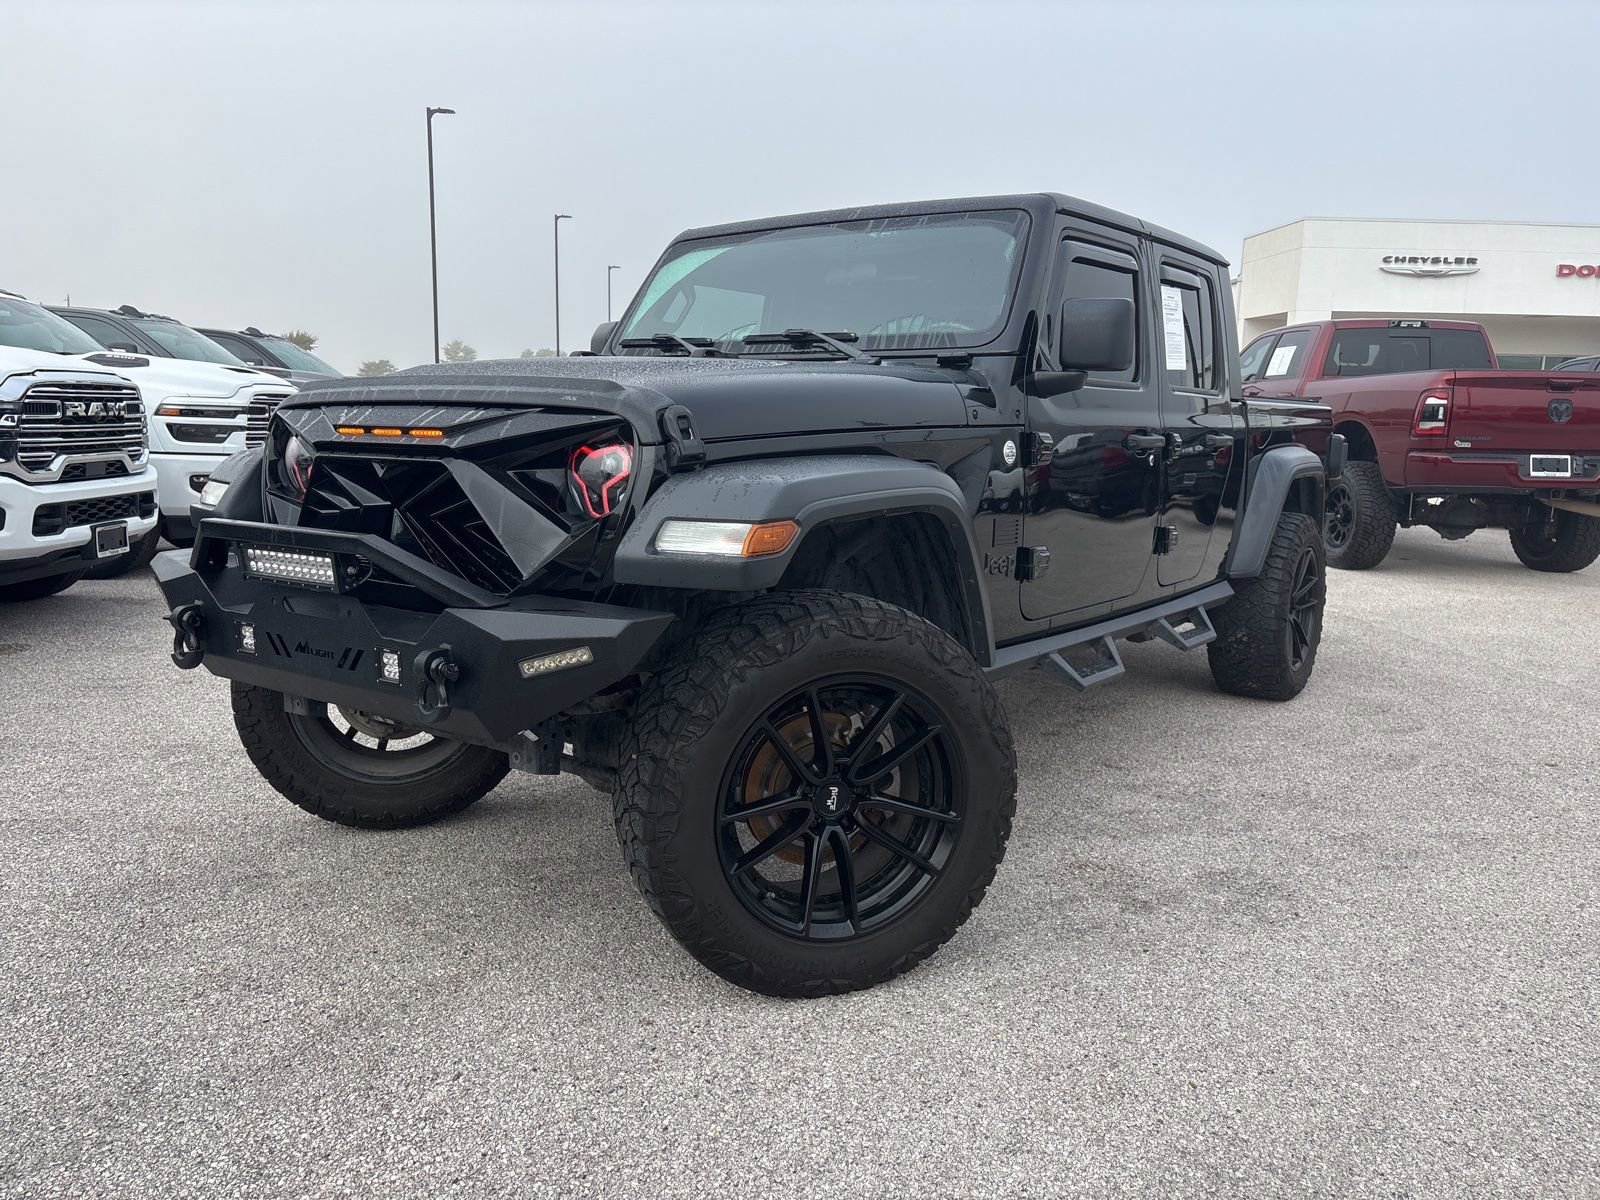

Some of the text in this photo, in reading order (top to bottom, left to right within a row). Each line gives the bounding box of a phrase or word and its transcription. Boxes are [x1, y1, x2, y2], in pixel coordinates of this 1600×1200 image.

[1382, 256, 1478, 265] CHRYSLER
[1556, 264, 1600, 277] DO
[64, 401, 125, 416] RAM
